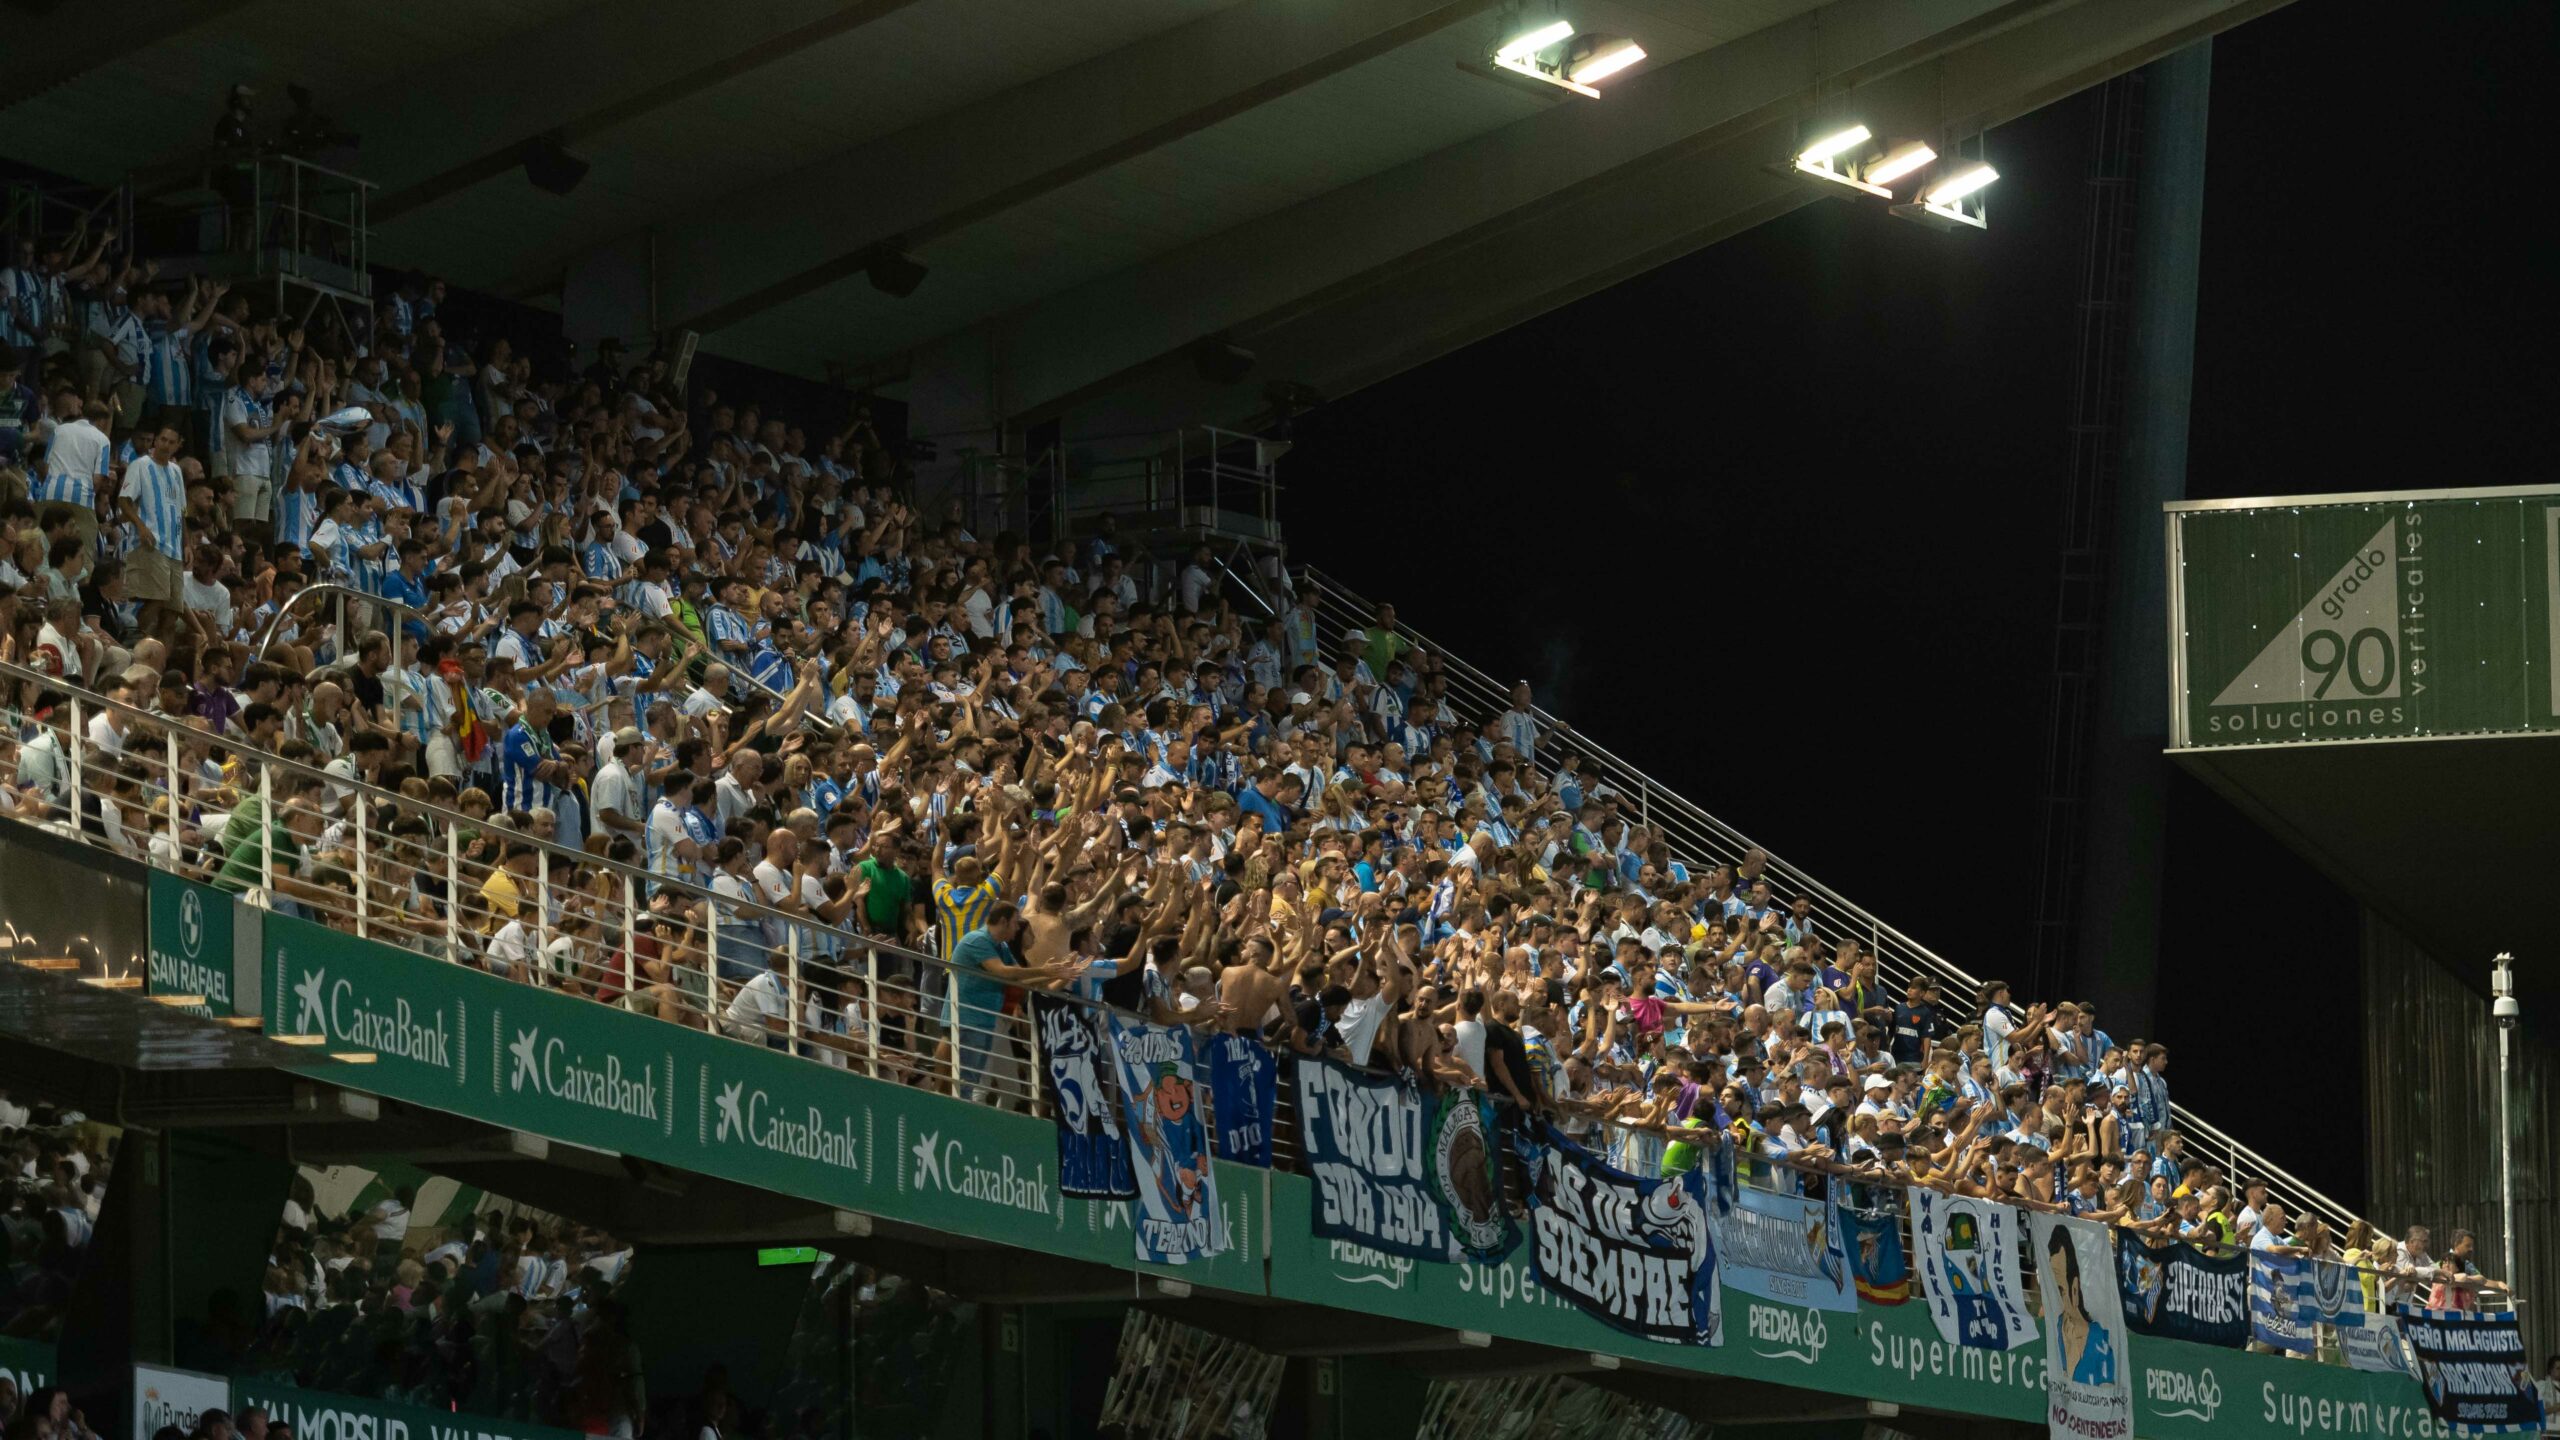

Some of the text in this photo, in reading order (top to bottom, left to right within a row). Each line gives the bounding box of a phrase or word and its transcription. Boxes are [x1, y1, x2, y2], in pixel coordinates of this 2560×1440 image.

[2321, 549, 2386, 620] grado
[2398, 512, 2427, 697] verticales
[2301, 627, 2395, 700] 90
[2210, 705, 2404, 732] soluciones
[151, 950, 230, 1004] SAN RAFAEL
[331, 978, 451, 1069] CaixaBank
[544, 1038, 659, 1121] CaixaBank
[749, 1090, 859, 1171] CaixaBank
[1298, 1060, 1423, 1181] FONDO
[944, 1140, 1050, 1214] CaixaBank
[1312, 1162, 1375, 1235] SUR
[1374, 1181, 1442, 1249] 1904
[1591, 1177, 1651, 1249] DE
[1534, 1205, 1690, 1327] SIEMPRE
[1920, 1193, 1950, 1318] MALAKA
[1990, 1213, 2022, 1331] HINCHAS
[2408, 1322, 2523, 1352] PEÑA MALAGUISTA
[2052, 1404, 2068, 1425] NO
